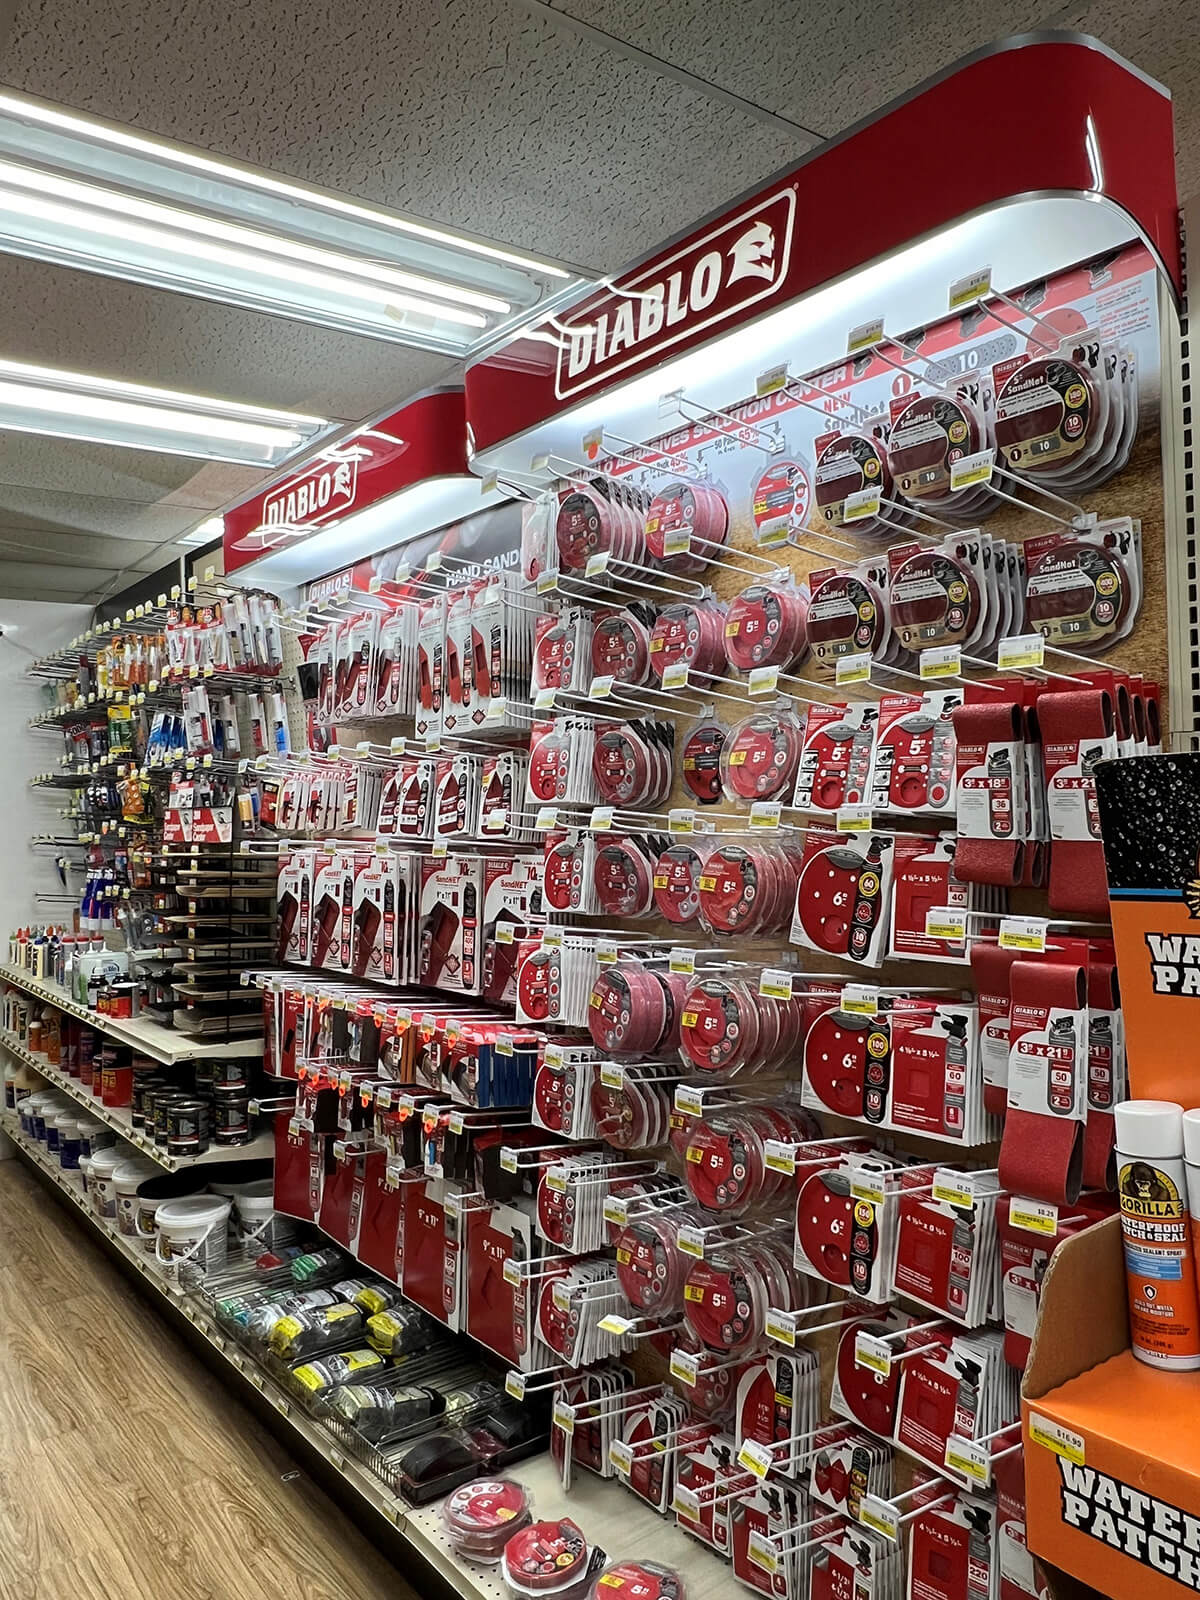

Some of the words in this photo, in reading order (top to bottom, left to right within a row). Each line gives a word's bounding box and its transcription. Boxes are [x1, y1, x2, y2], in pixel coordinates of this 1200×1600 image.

[568, 250, 724, 378] DIABLO
[960, 350, 978, 371] 10
[896, 378, 905, 390] 1
[1007, 375, 1044, 395] SandNet
[823, 391, 852, 414] NEW
[1040, 441, 1050, 451] 10
[926, 472, 936, 482] 10
[267, 471, 331, 530] DIABLO
[484, 551, 522, 575] SAND
[1039, 559, 1076, 574] SandNet
[1099, 603, 1110, 612] 10
[926, 627, 936, 636] 10
[1069, 622, 1080, 632] 10
[838, 644, 847, 653] 10
[978, 780, 985, 788] x
[1071, 780, 1079, 788] x
[952, 893, 963, 902] 40
[1015, 1007, 1039, 1015] DIABLO
[872, 1040, 884, 1050] 100
[1036, 1046, 1044, 1055] x
[1056, 1073, 1067, 1082] 50
[1094, 1069, 1106, 1078] 50
[870, 1094, 879, 1104] 10
[1053, 1096, 1060, 1105] 2
[857, 1208, 870, 1220] 150
[1154, 1232, 1187, 1243] SEAL
[952, 1251, 970, 1264] 100
[855, 1263, 865, 1275] 10
[957, 1412, 973, 1427] 150
[969, 1566, 988, 1580] 220
